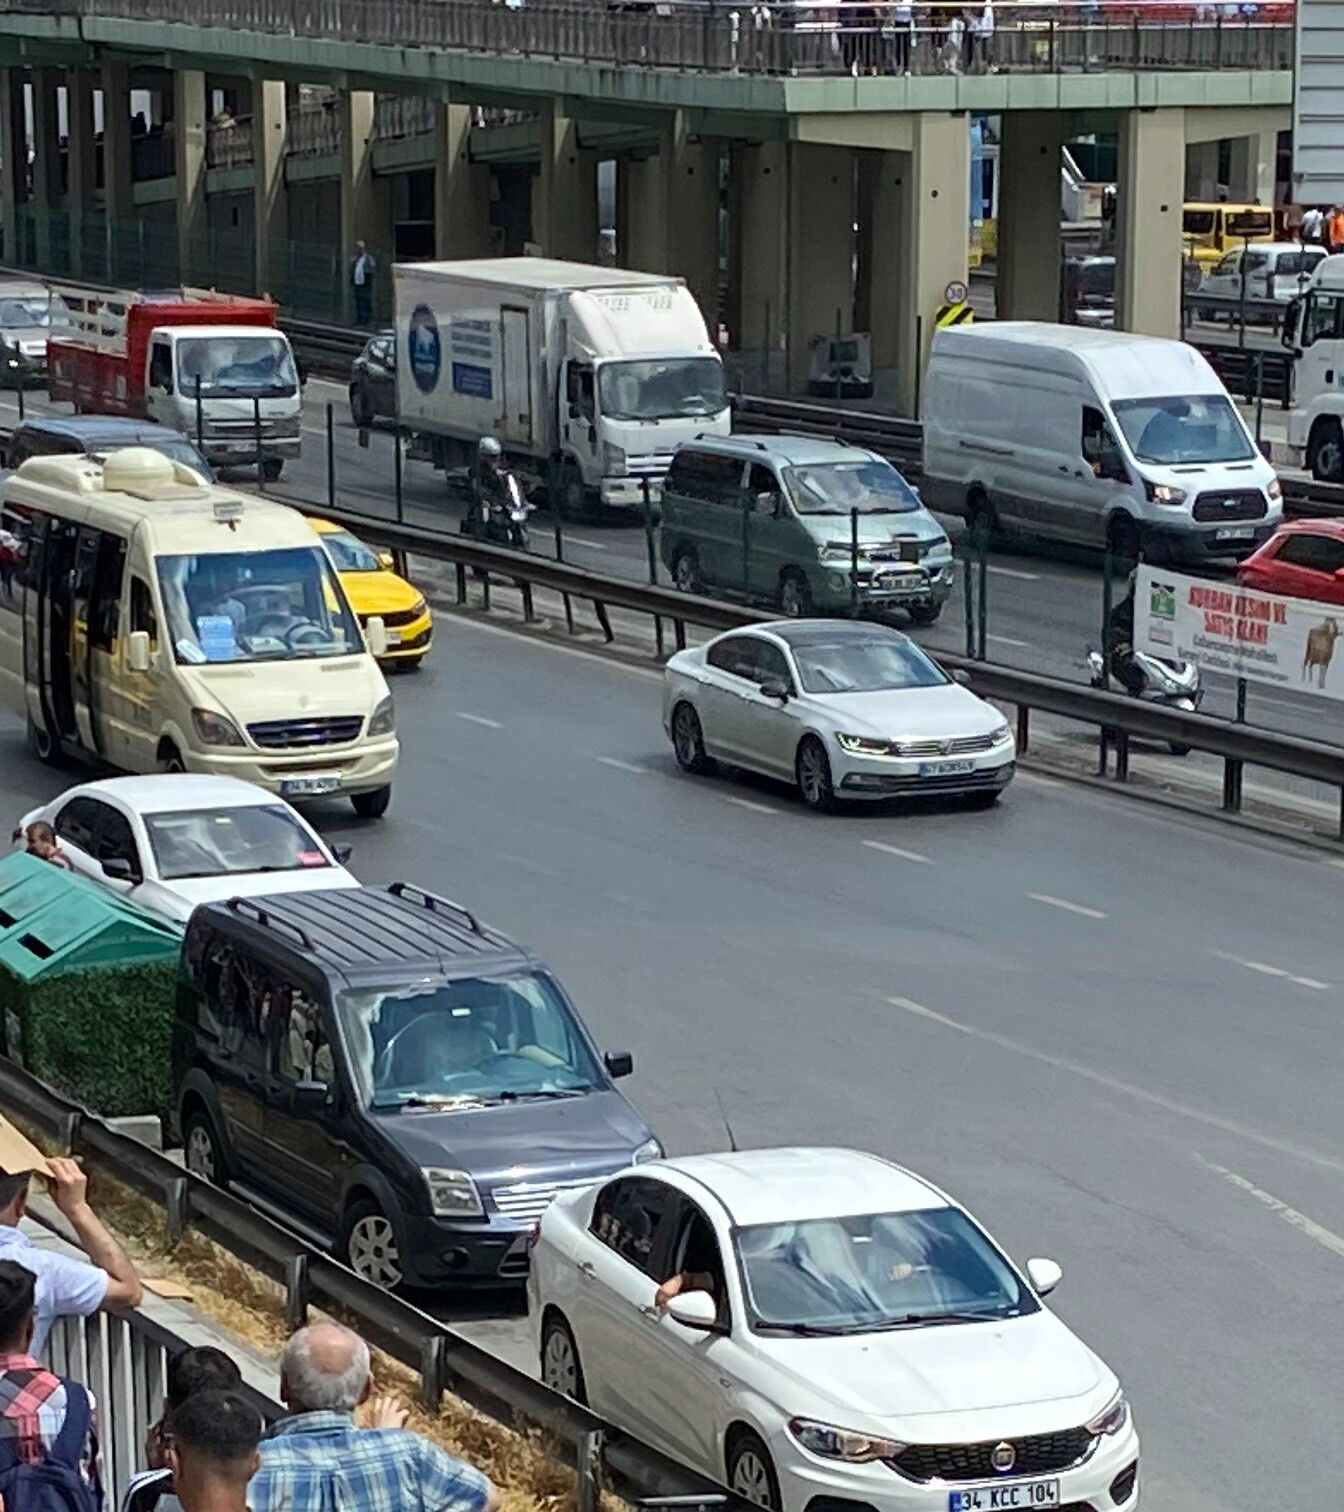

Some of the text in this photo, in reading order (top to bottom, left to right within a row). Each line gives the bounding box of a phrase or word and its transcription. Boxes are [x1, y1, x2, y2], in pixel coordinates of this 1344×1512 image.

[962, 1484, 1054, 1510] 34 KCC 104
